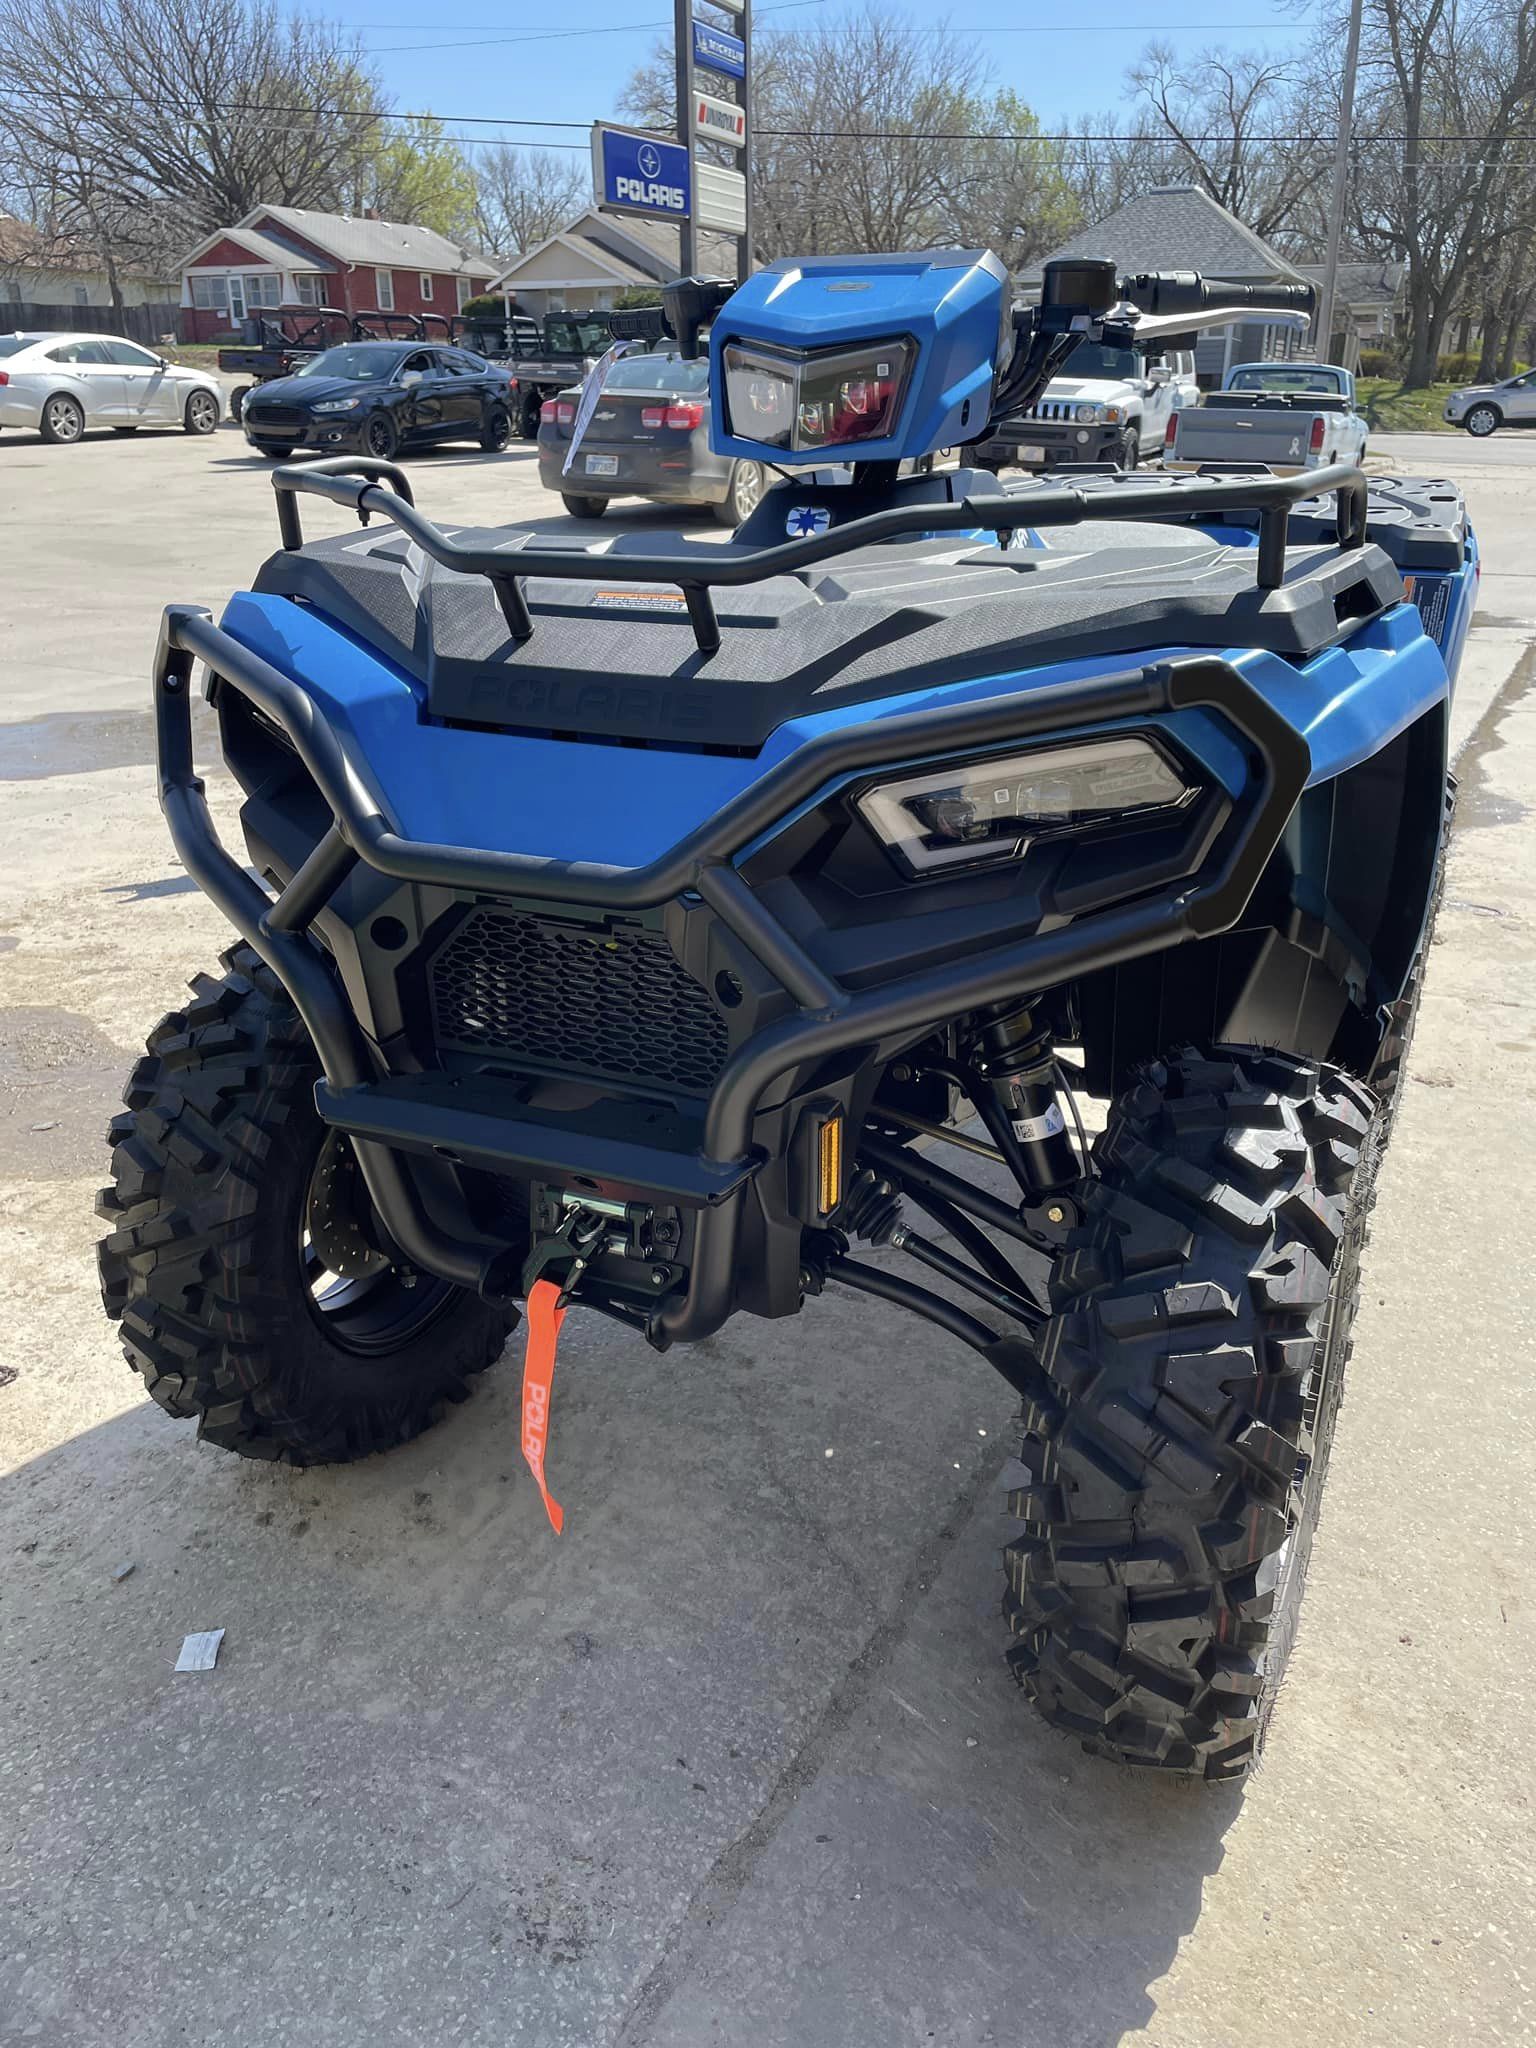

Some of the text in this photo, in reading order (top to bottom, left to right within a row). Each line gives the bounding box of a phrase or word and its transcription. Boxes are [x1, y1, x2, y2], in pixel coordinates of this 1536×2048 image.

[616, 176, 685, 210] POLARIS
[464, 672, 714, 730] POLARIS
[526, 1381, 547, 1484] POLAR
